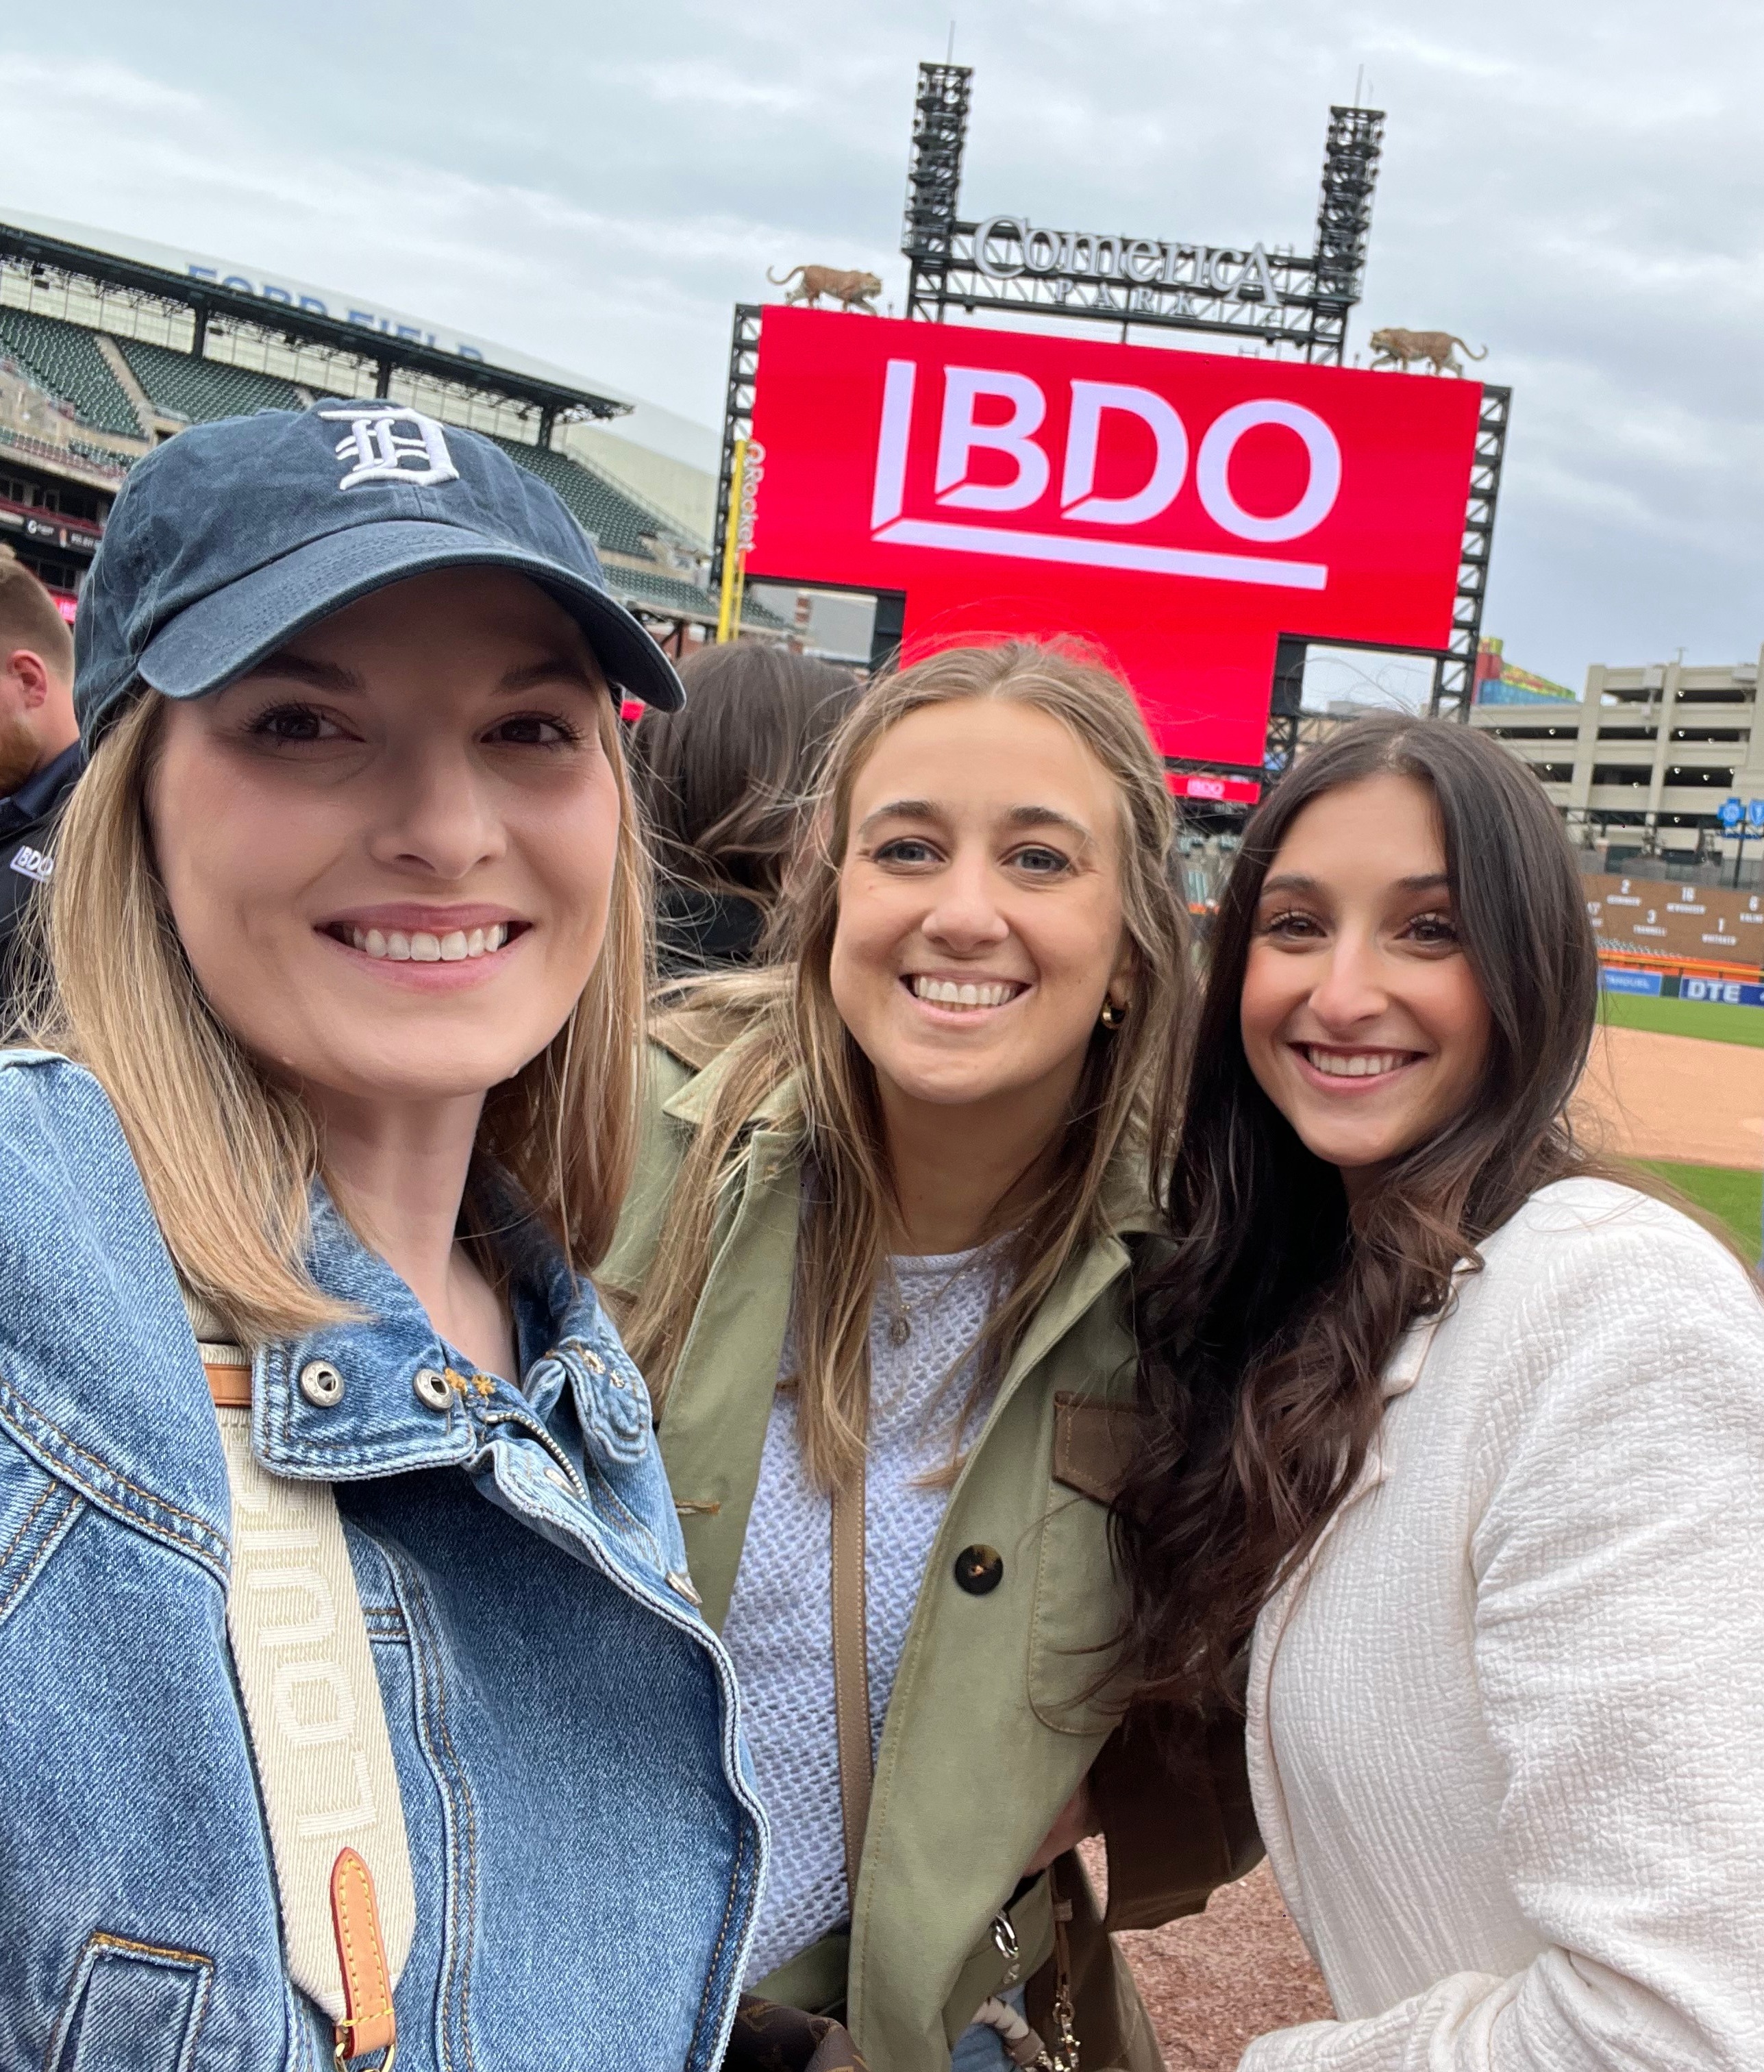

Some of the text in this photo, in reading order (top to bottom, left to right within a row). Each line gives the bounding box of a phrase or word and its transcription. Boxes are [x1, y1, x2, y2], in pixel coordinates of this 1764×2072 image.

[1055, 280, 1197, 317] PARK
[319, 408, 460, 491] D
[935, 364, 1343, 543] BDO
[17, 846, 54, 877] BDO
[1687, 978, 1741, 1004] DTE
